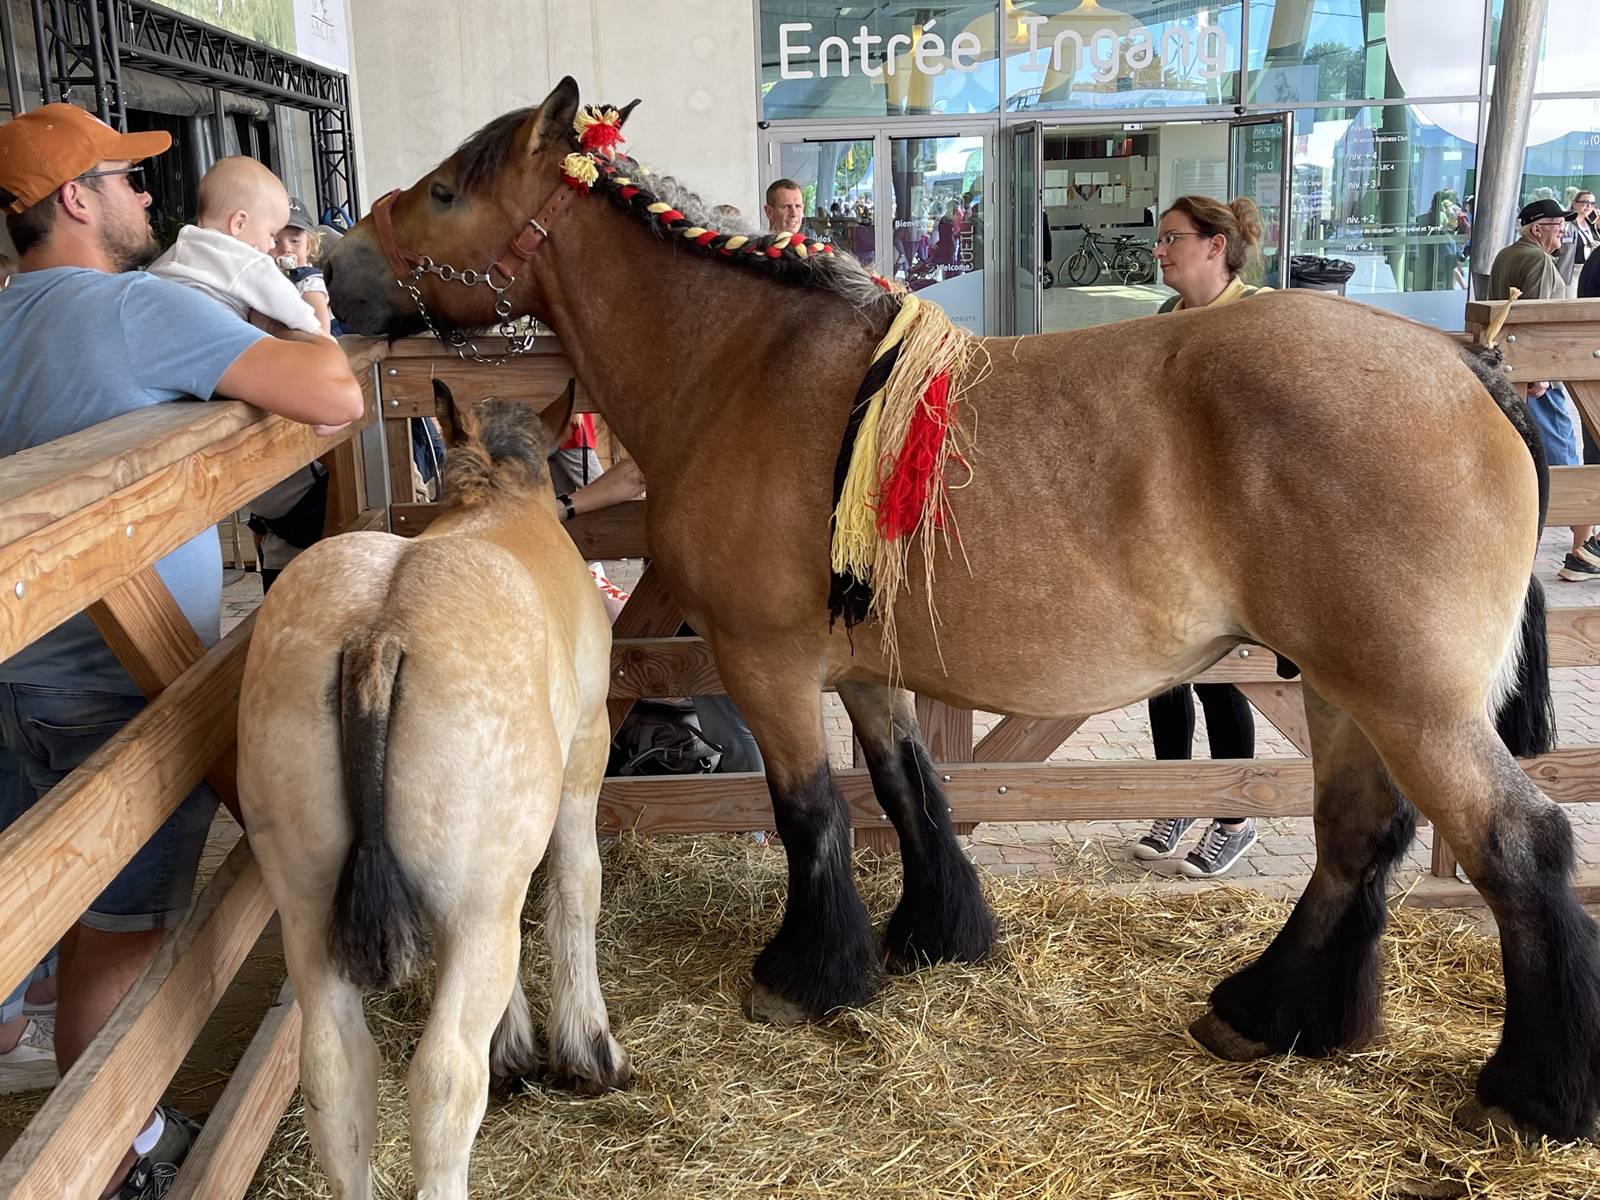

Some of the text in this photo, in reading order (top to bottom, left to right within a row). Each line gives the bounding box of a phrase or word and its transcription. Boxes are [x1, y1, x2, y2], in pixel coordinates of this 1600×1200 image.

[779, 15, 1226, 82] Entrée Ingang
[936, 263, 970, 272] Welcome
